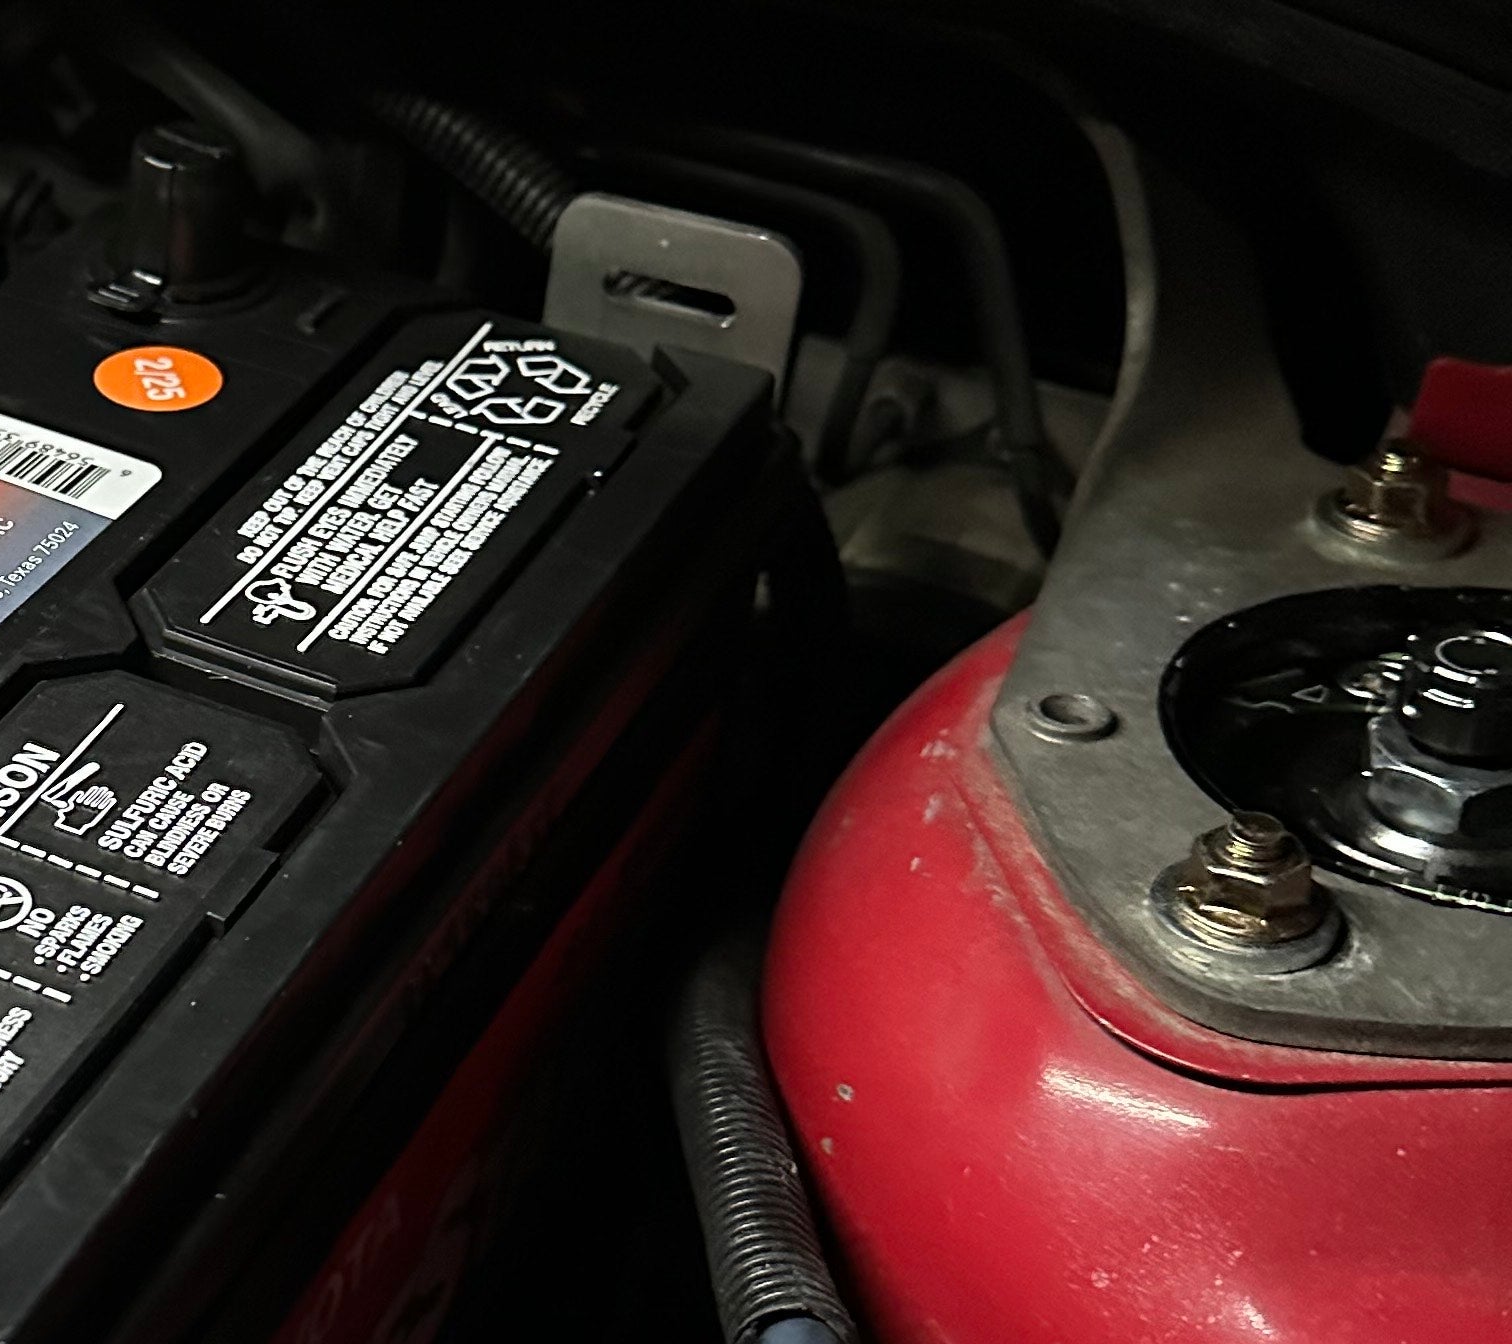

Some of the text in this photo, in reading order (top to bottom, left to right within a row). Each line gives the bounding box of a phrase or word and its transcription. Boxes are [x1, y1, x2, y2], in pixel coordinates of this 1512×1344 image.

[132, 355, 187, 403] 2/25
[23, 439, 95, 468] 56489
[118, 468, 133, 479] 6
[269, 433, 419, 580] FLUSH EYES IMMEDIATELY
[294, 551, 342, 586] WITH
[366, 482, 404, 510] GET
[320, 477, 440, 595] MEDICAL HELP FAST
[32, 521, 80, 556] 75024
[97, 741, 208, 851] SULFURIC ACID
[123, 790, 195, 858] CAN CAUSE
[143, 782, 230, 867] BLINDNESS OR
[167, 789, 251, 875] SEVERE BURNS
[16, 907, 56, 938] NO
[34, 905, 92, 958] SPARKS
[56, 913, 114, 967] FLAMES
[79, 914, 144, 975] SMOKING
